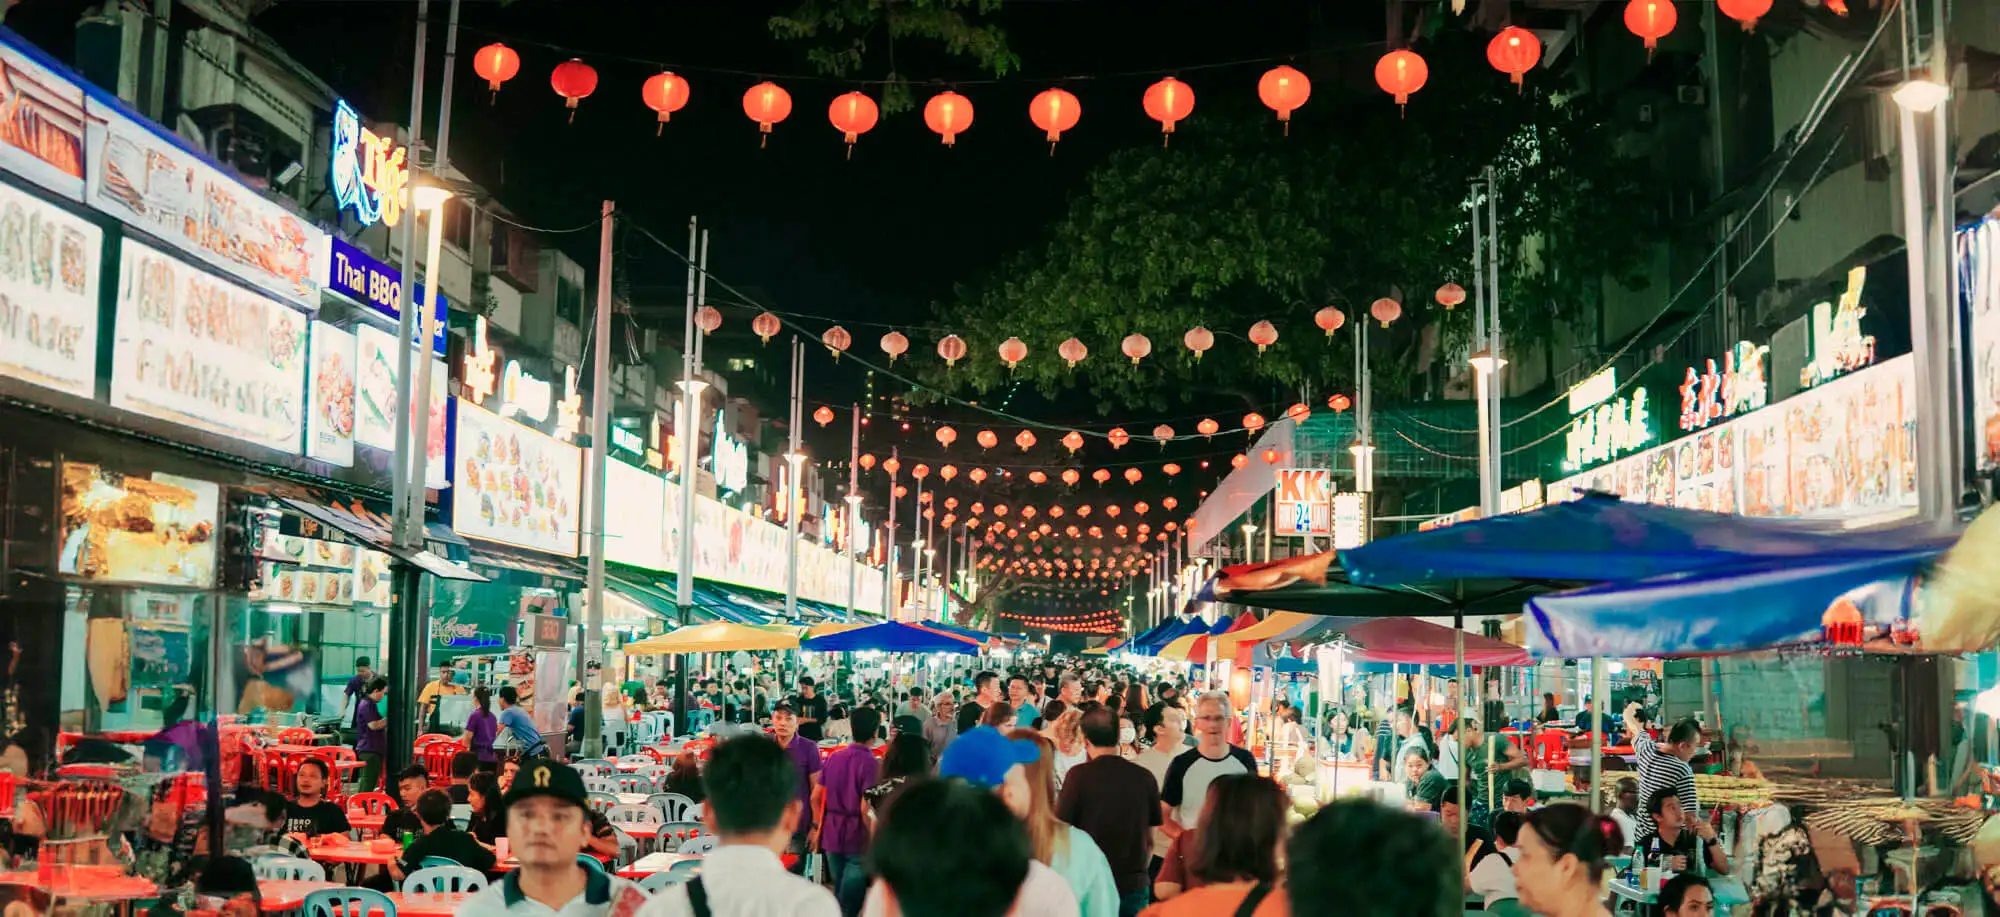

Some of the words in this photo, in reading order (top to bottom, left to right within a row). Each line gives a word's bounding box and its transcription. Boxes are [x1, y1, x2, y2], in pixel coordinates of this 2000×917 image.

[336, 252, 365, 296] Thai
[370, 270, 401, 313] BBQ
[1282, 469, 1326, 501] KK
[1296, 503, 1310, 532] 24
